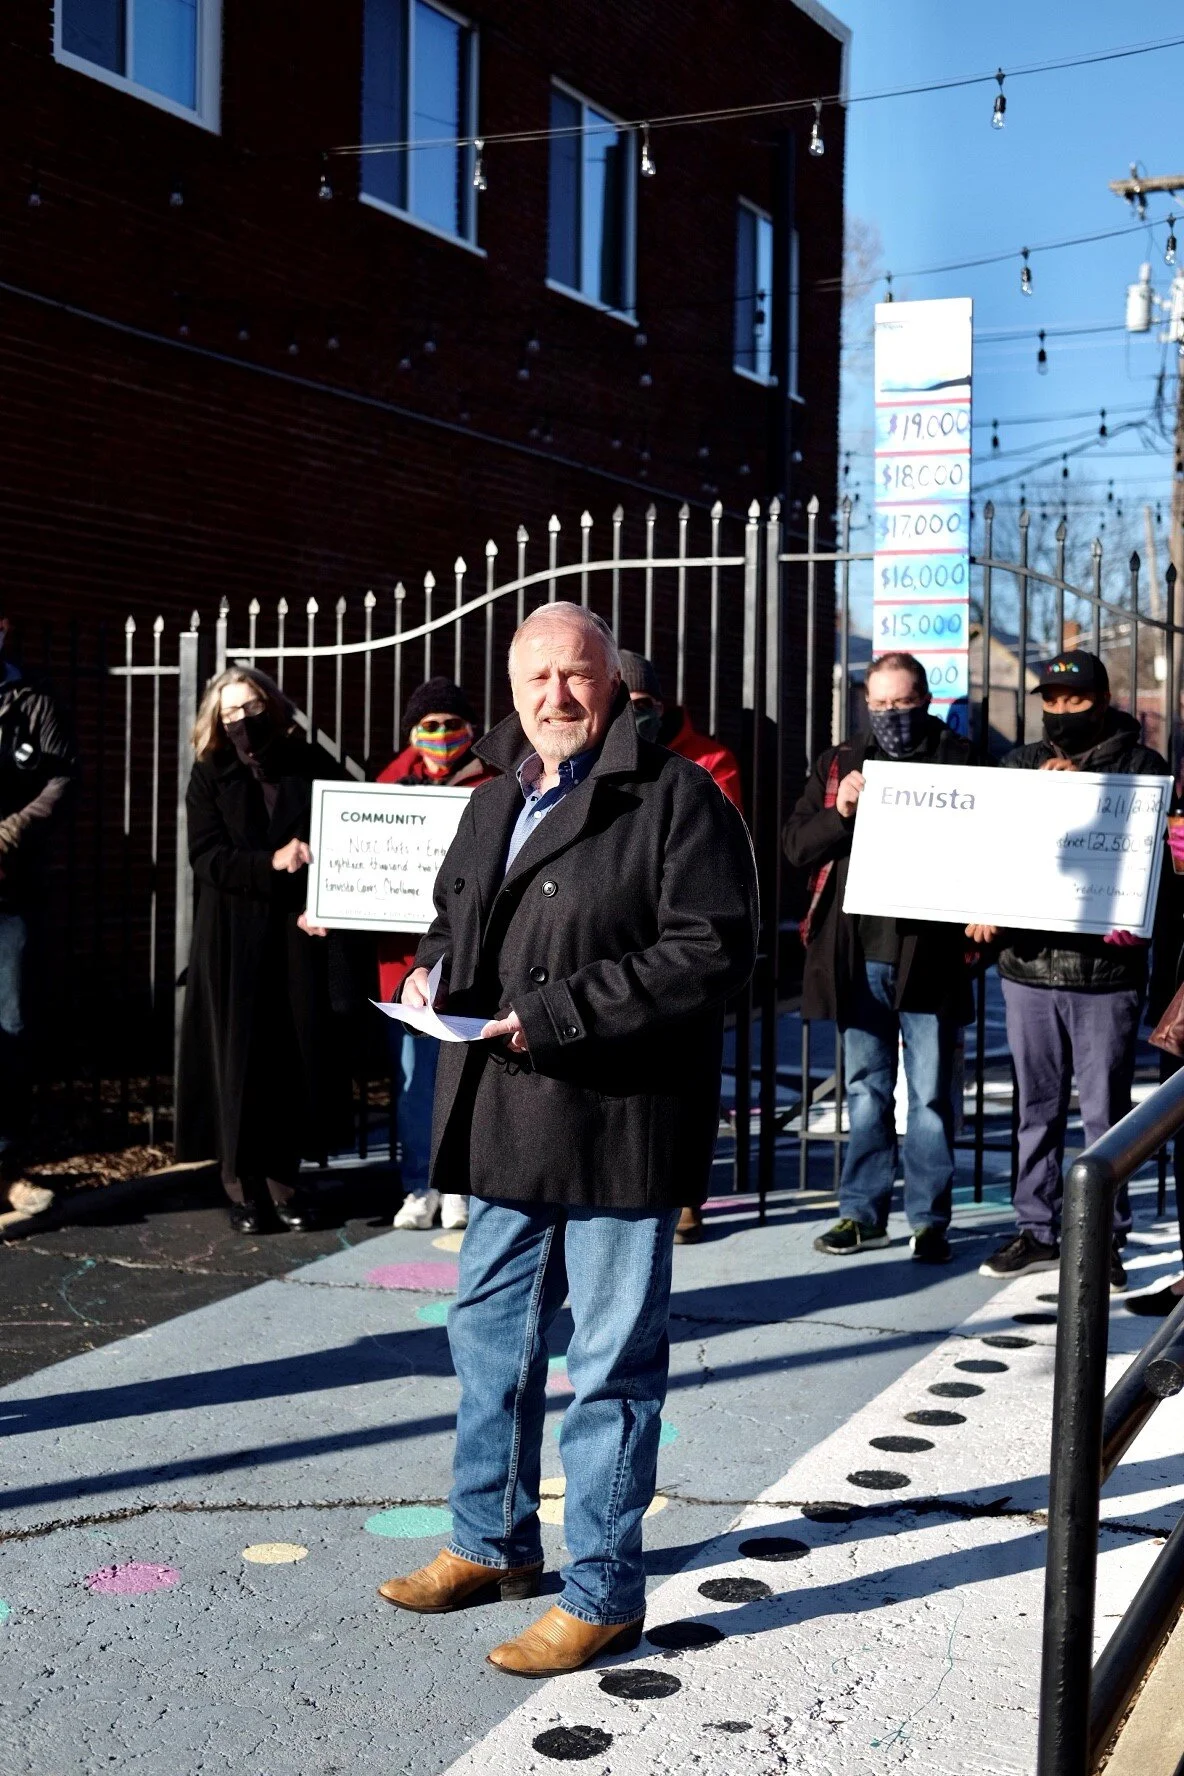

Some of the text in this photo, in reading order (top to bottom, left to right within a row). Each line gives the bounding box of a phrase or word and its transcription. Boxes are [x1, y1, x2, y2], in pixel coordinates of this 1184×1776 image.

[882, 463, 963, 490] $18,000
[881, 512, 961, 538] $17,000
[881, 563, 965, 590] $16,000
[880, 613, 962, 637] $15,000
[881, 785, 976, 810] Envista
[340, 811, 427, 826] COMMUNITY
